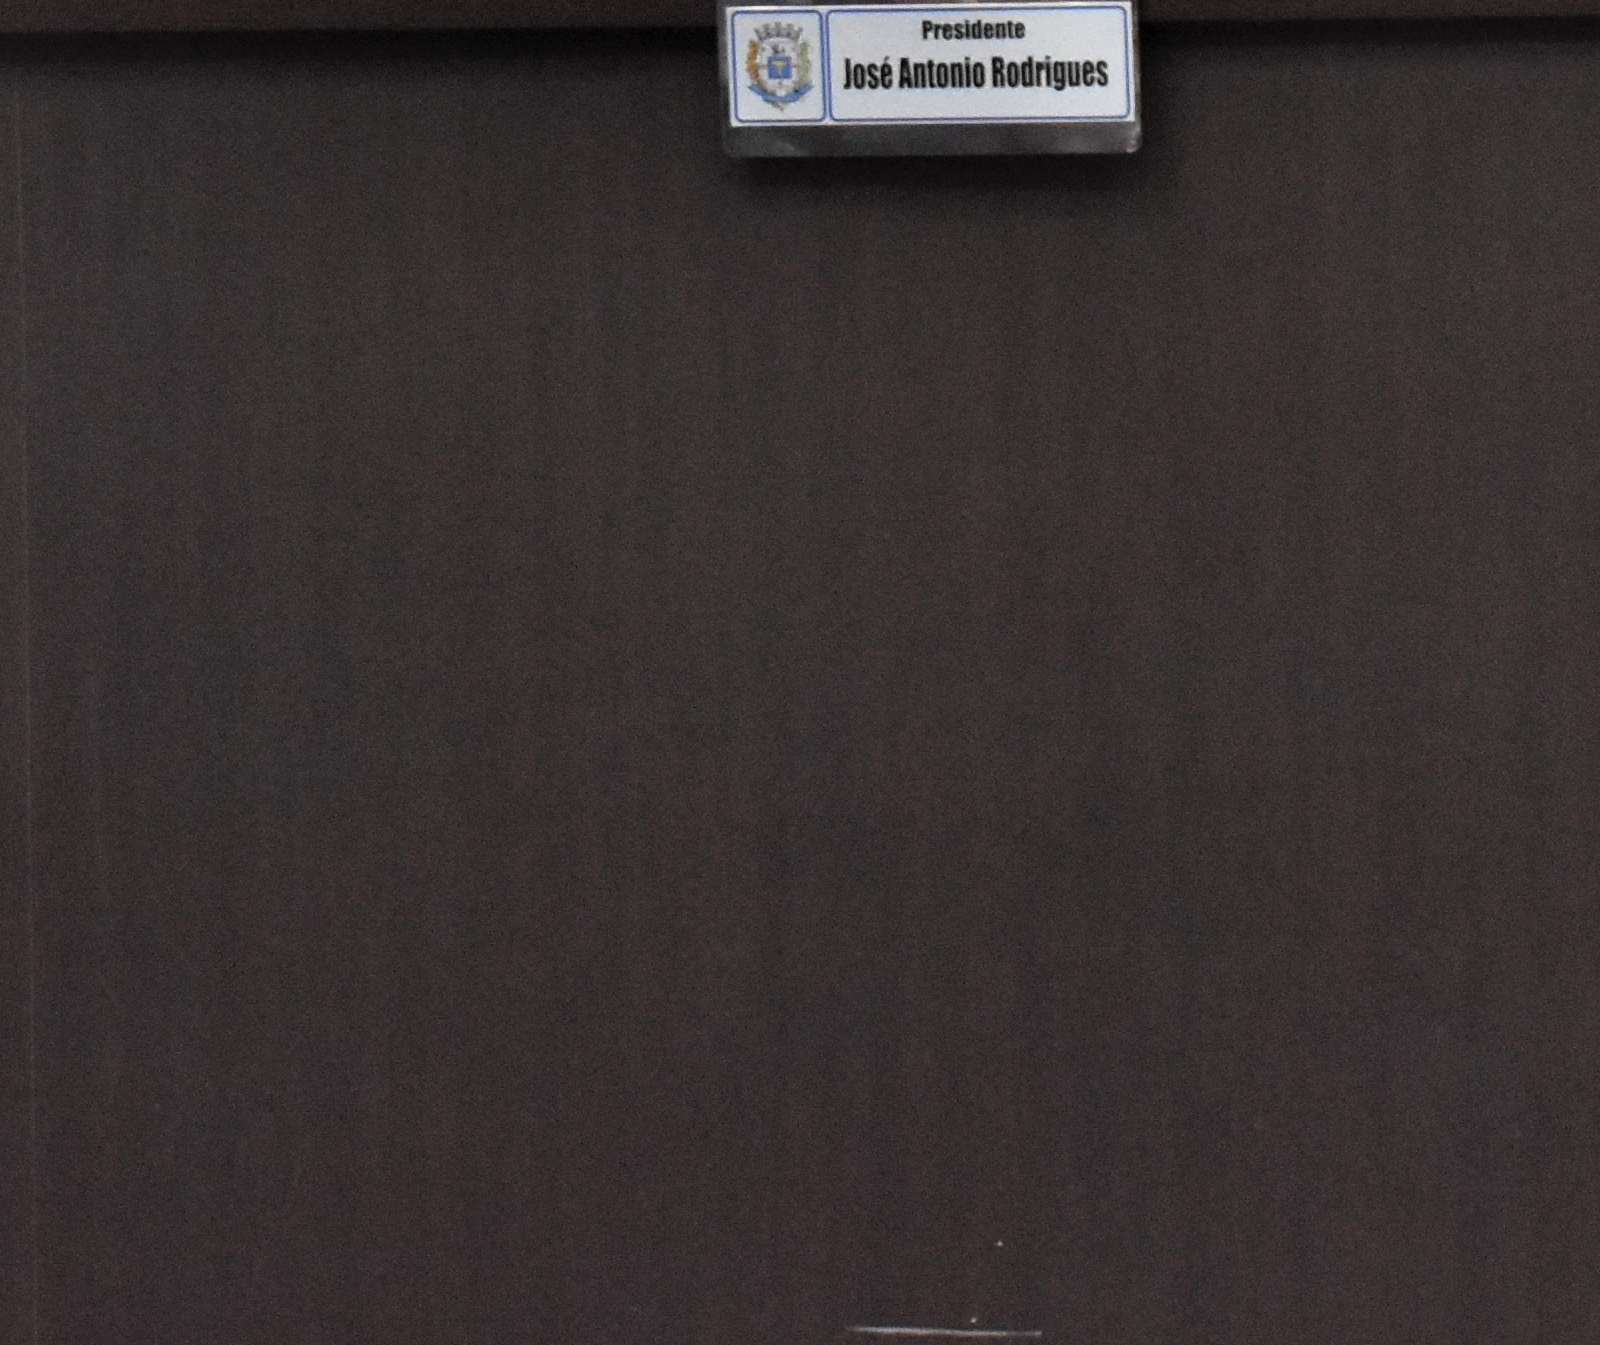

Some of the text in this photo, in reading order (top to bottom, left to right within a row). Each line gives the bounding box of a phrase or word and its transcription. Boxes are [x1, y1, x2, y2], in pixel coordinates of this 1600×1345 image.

[921, 19, 1026, 40] Presidente
[843, 55, 1109, 91] José Antonio Rodrigues
